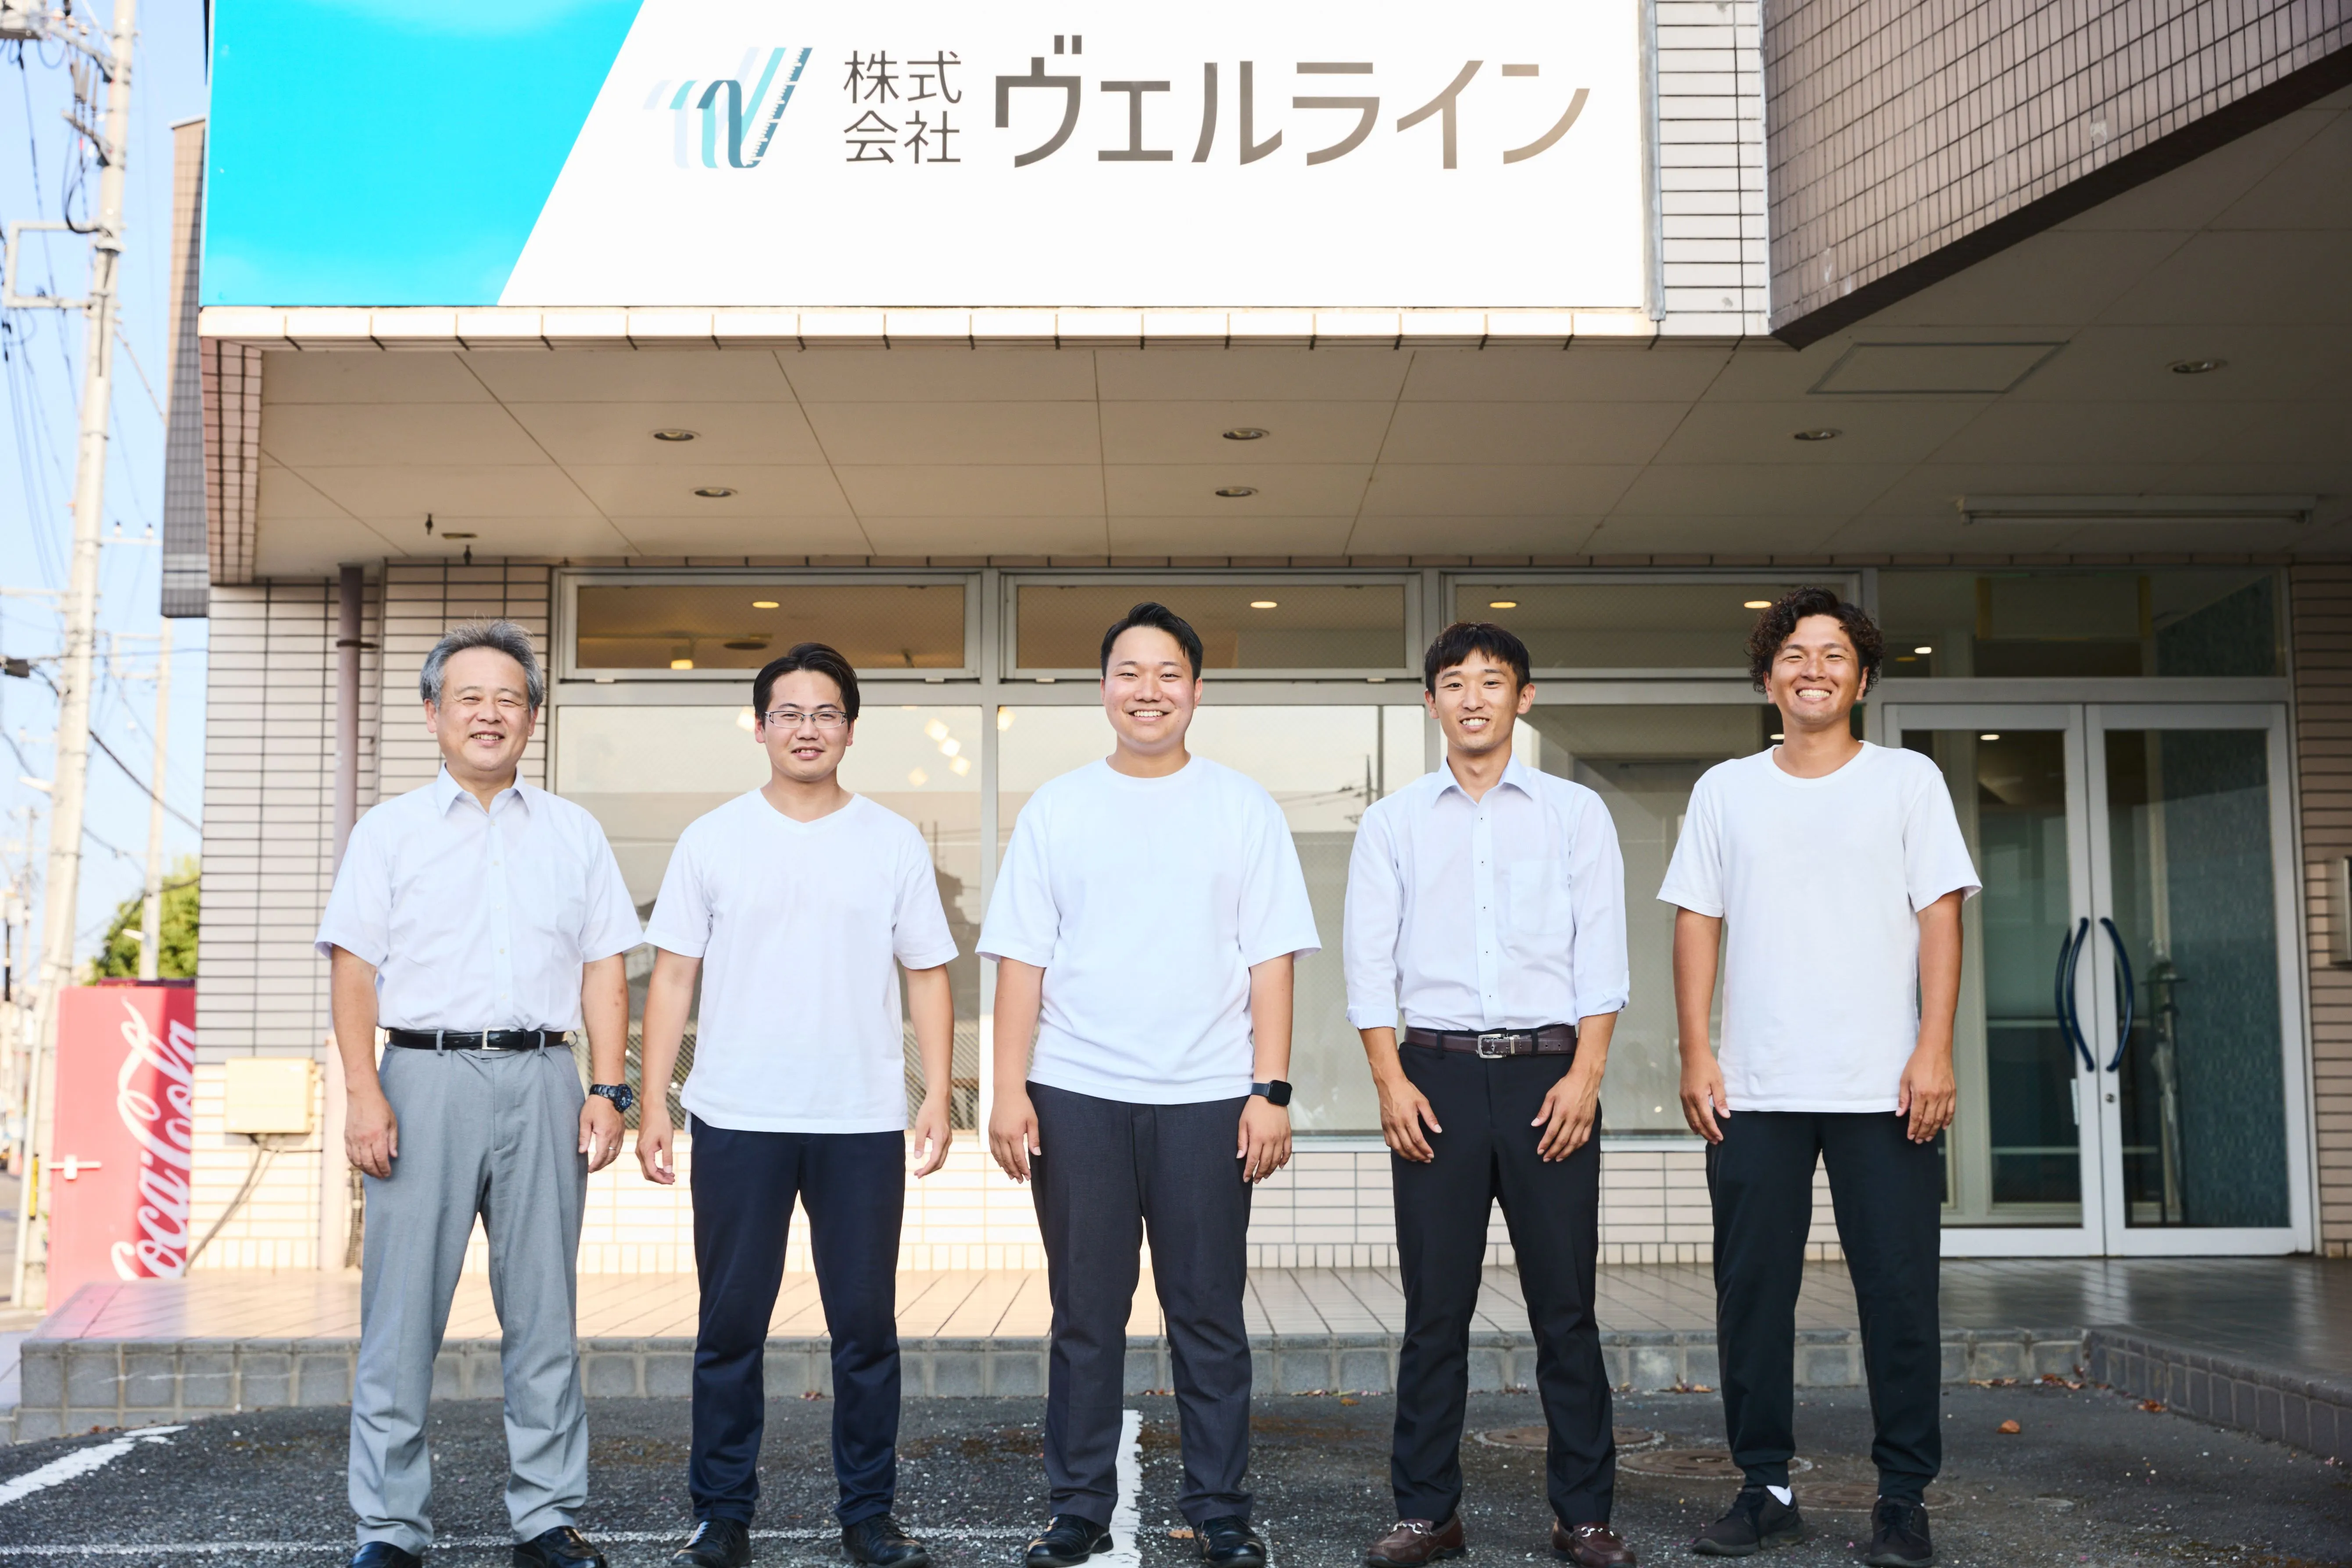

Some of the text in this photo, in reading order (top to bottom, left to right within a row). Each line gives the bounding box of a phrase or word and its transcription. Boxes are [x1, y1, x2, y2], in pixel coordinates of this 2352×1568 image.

[843, 50, 962, 104] 株式
[995, 34, 1590, 169] ヴェルライン
[843, 110, 961, 164] 会社
